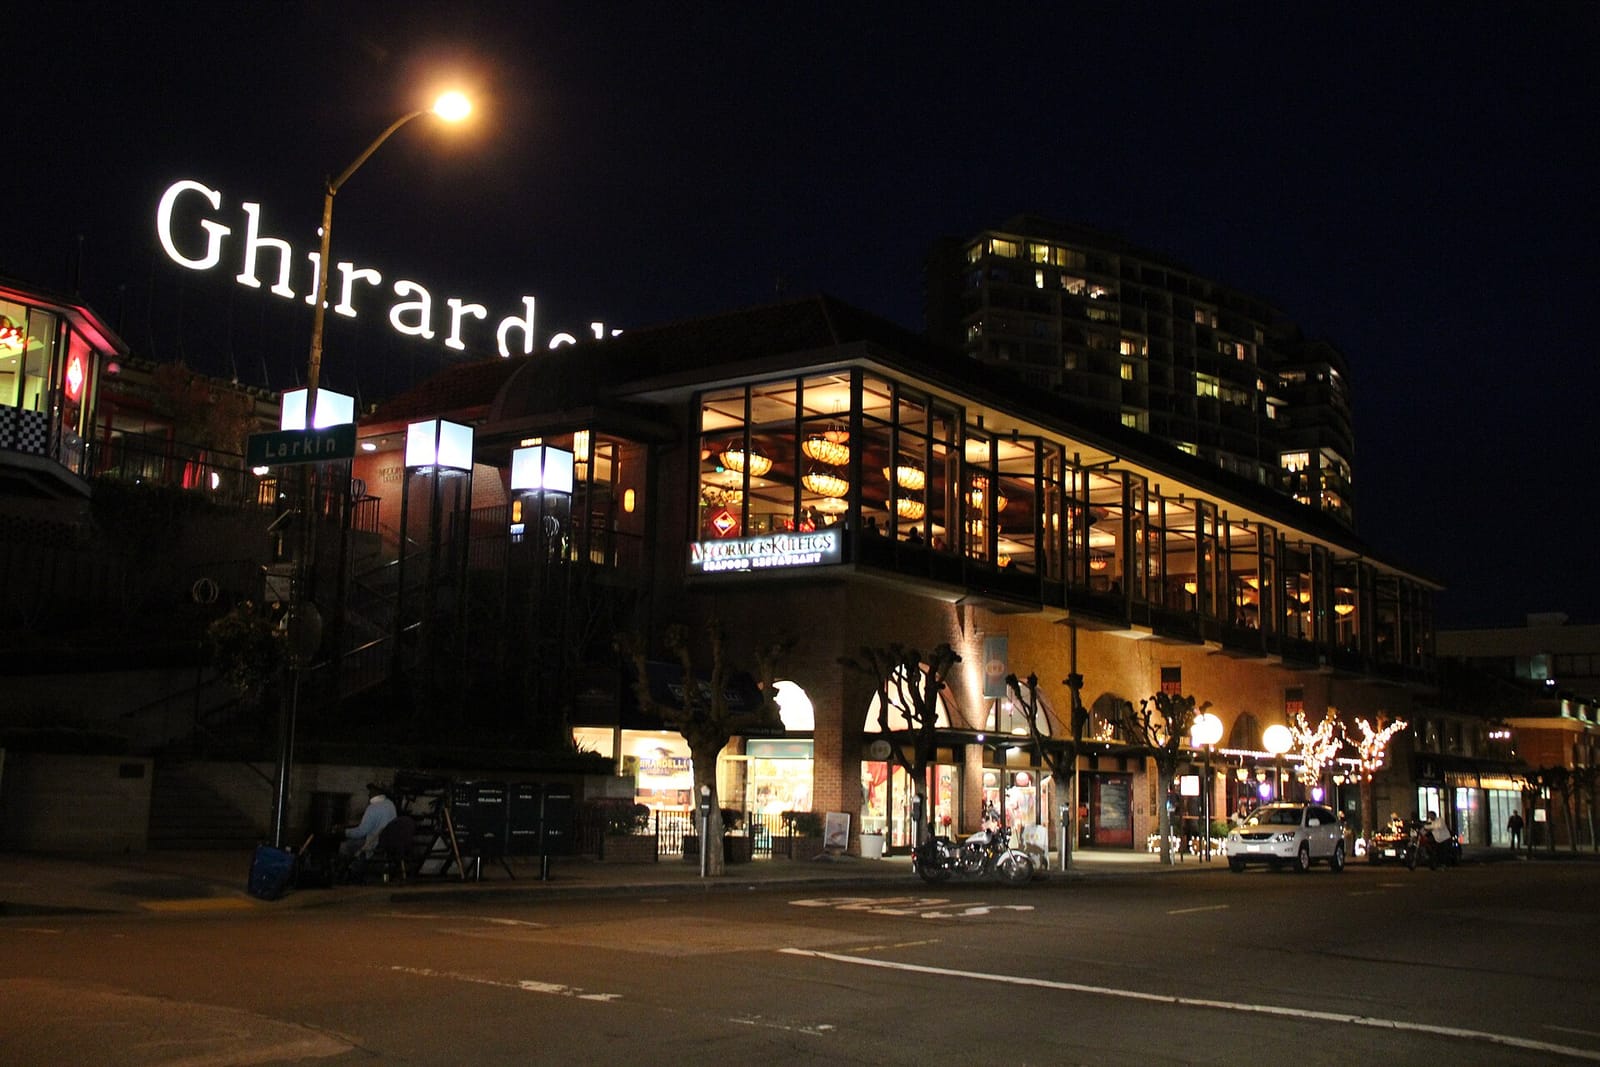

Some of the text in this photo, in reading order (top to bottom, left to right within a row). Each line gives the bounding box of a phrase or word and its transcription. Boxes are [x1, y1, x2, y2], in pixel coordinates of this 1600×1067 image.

[264, 435, 337, 459] Larkin
[703, 552, 822, 572] SEAFOOD RESTAURANT
